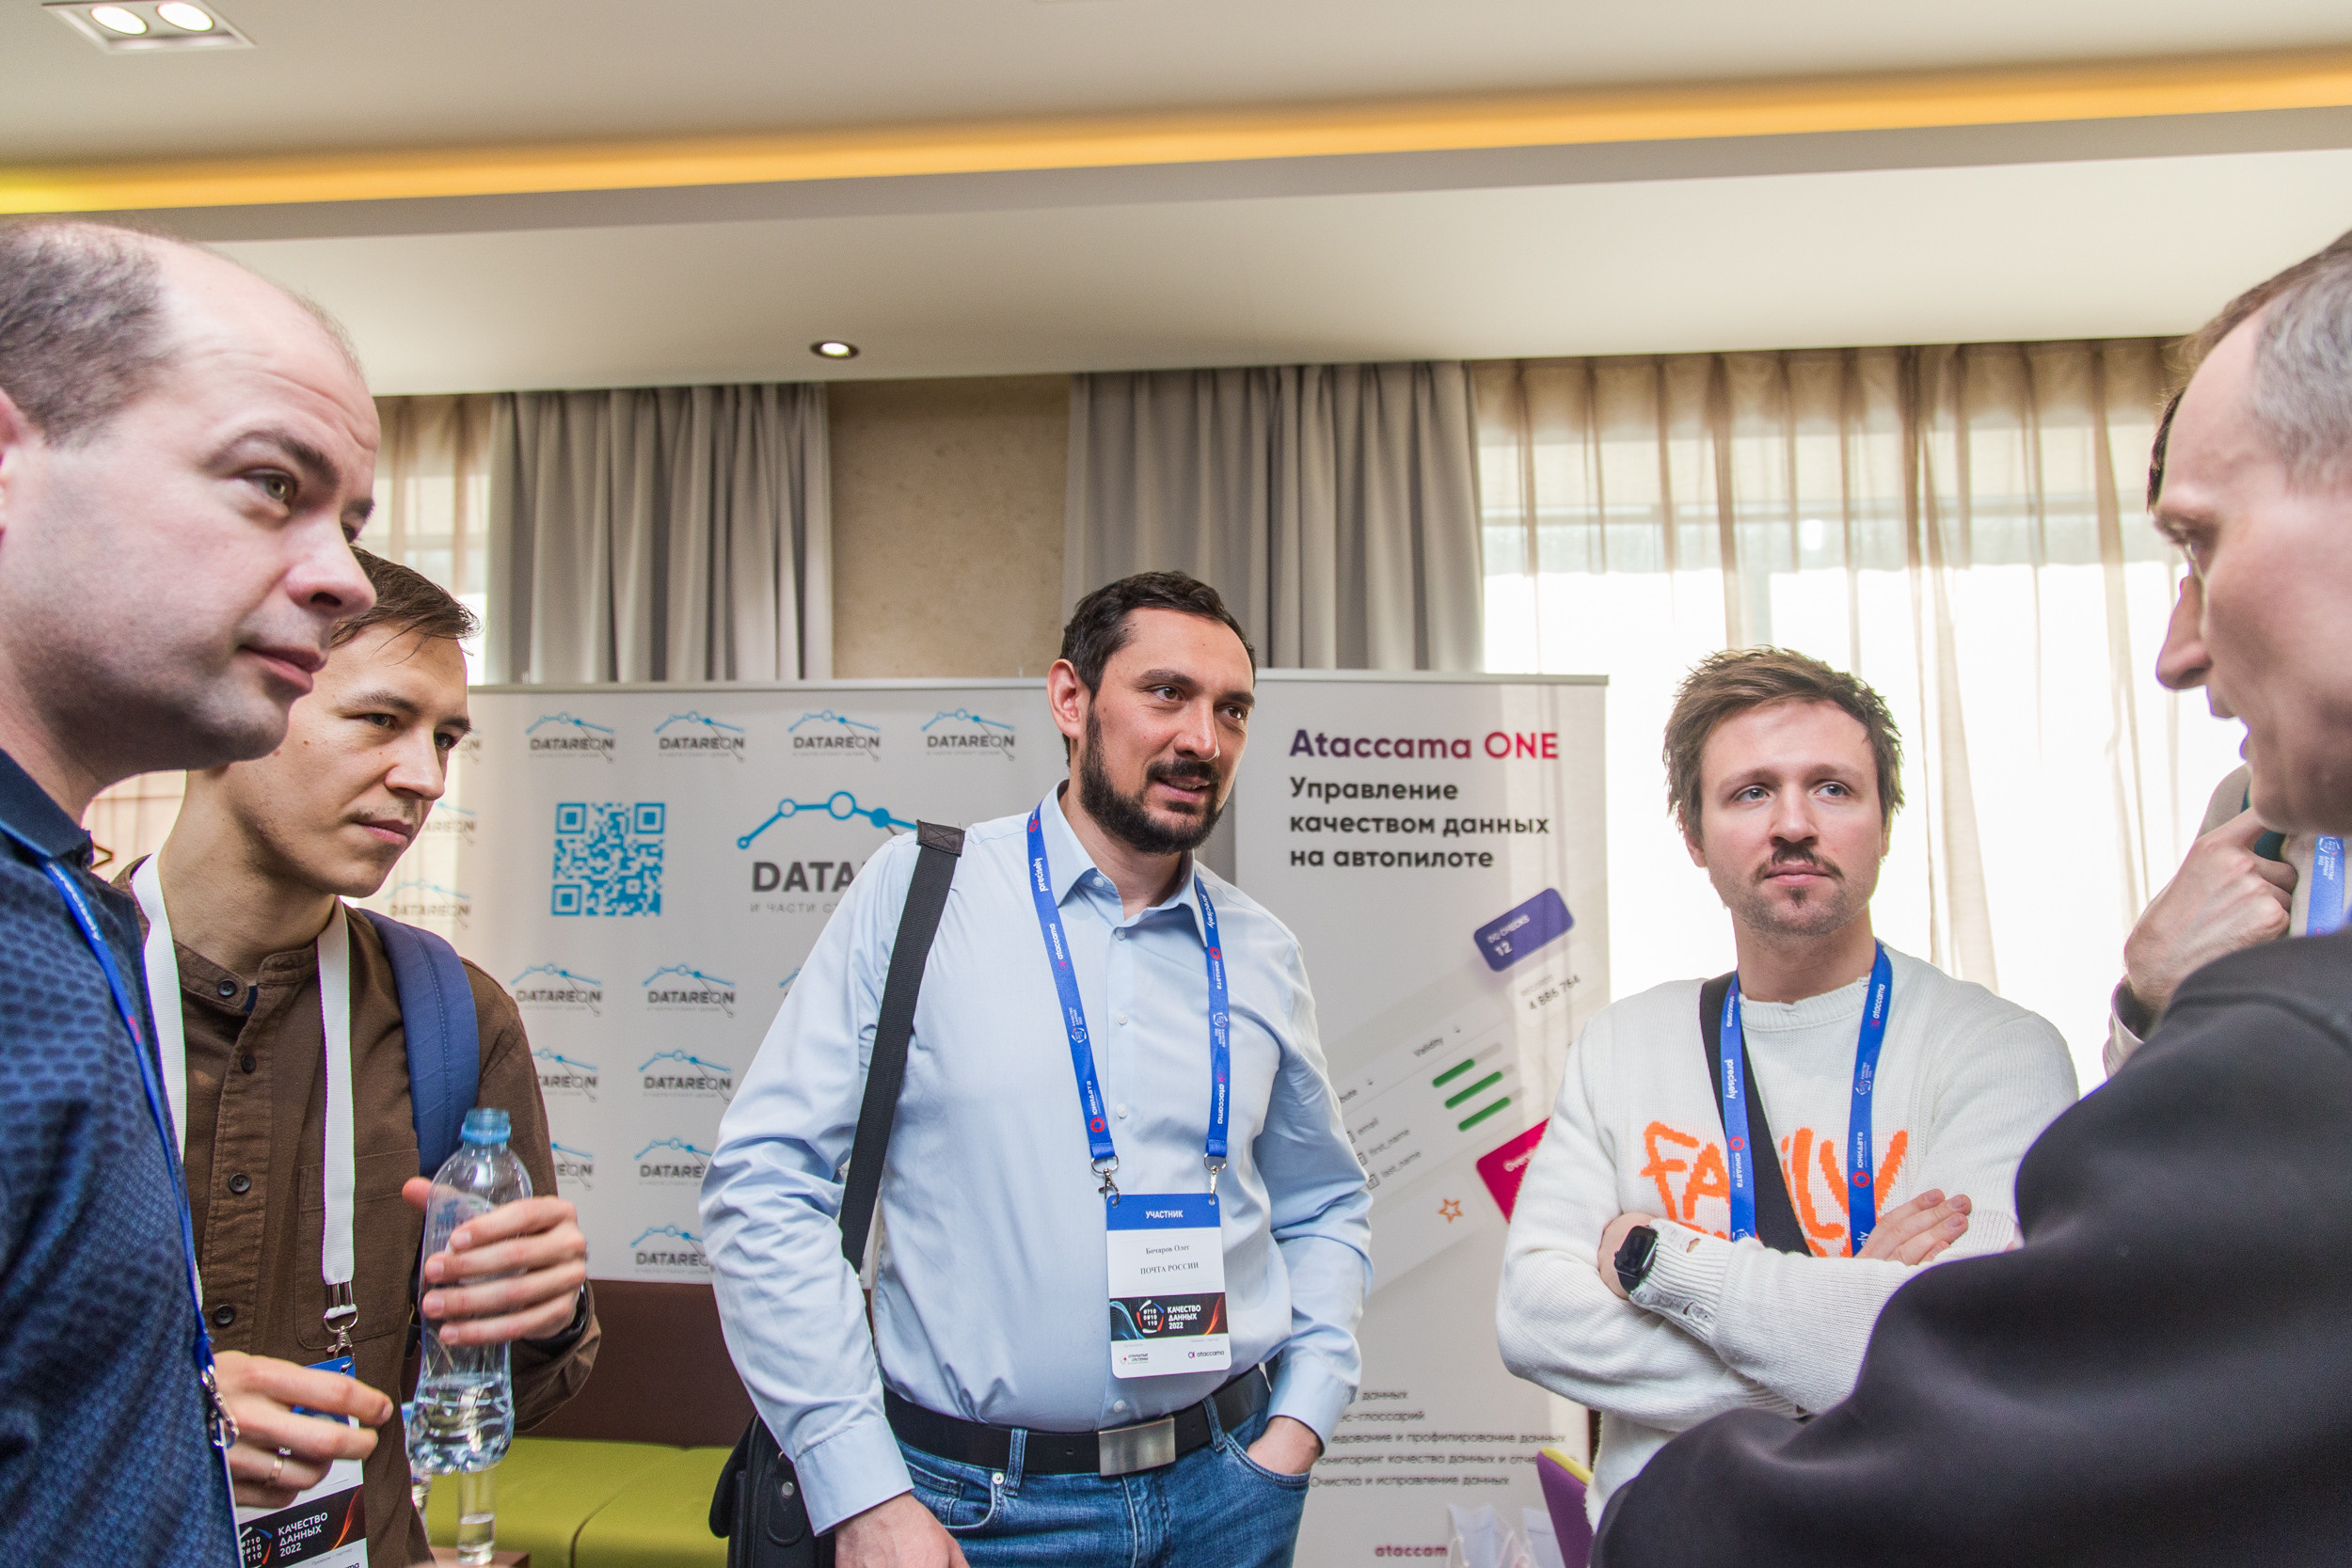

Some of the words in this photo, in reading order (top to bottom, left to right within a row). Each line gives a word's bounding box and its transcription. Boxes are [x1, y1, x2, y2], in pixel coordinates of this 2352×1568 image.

[530, 736, 615, 752] DATAREON
[660, 736, 745, 751] DATAREON
[793, 735, 881, 750] DATAREON
[927, 735, 1015, 749] DATAREON
[1289, 729, 1472, 759] Ataccama
[1484, 731, 1560, 760] ONE
[1289, 776, 1459, 804] Управление
[1290, 816, 1436, 834] качеством
[1442, 817, 1550, 837] данных
[1290, 849, 1325, 866] на
[1333, 850, 1494, 867] автопилоте
[752, 862, 866, 893] DATA
[1033, 857, 1050, 893] precisely
[750, 902, 762, 913] И
[766, 902, 816, 913] ЧАСТИ
[1200, 893, 1215, 929] precisely
[1049, 923, 1064, 960] ataccama
[1494, 940, 1513, 957] 12
[516, 990, 603, 1004] DATAREON
[647, 990, 736, 1005] DATAREON
[1872, 983, 1886, 1020] ataccama
[644, 1076, 732, 1091] DATAREON
[1724, 1058, 1737, 1100] precisely
[1216, 1083, 1225, 1125] ataccama
[640, 1164, 707, 1178] DATARE
[1145, 1210, 1184, 1219] УЧАСТНИК
[1145, 1246, 1173, 1256] Бочаров
[635, 1252, 710, 1266] DATAREO
[1140, 1265, 1167, 1275] ПОЧТА
[1168, 1261, 1200, 1273] РОССИИ
[1167, 1304, 1201, 1314] КАЧЕСТВО
[1168, 1312, 1198, 1323] ДАННЫХ
[1168, 1321, 1184, 1330] 2022
[1340, 1409, 1425, 1424] ес-глоссарий
[1331, 1433, 1392, 1445] едование
[1407, 1430, 1516, 1445] профилирование
[1519, 1433, 1566, 1445] данных
[1318, 1454, 1383, 1467] ониторинг
[1388, 1454, 1445, 1465] качества
[1449, 1454, 1495, 1465] данных
[1309, 1475, 1362, 1488] Очистка
[1375, 1475, 1458, 1488] исправление
[1462, 1475, 1510, 1487] данных
[278, 1512, 328, 1537] КАЧЕСТВО
[278, 1524, 323, 1547] ДАННЫХ
[279, 1542, 302, 1558] 2022
[1374, 1544, 1449, 1559] ataccam
